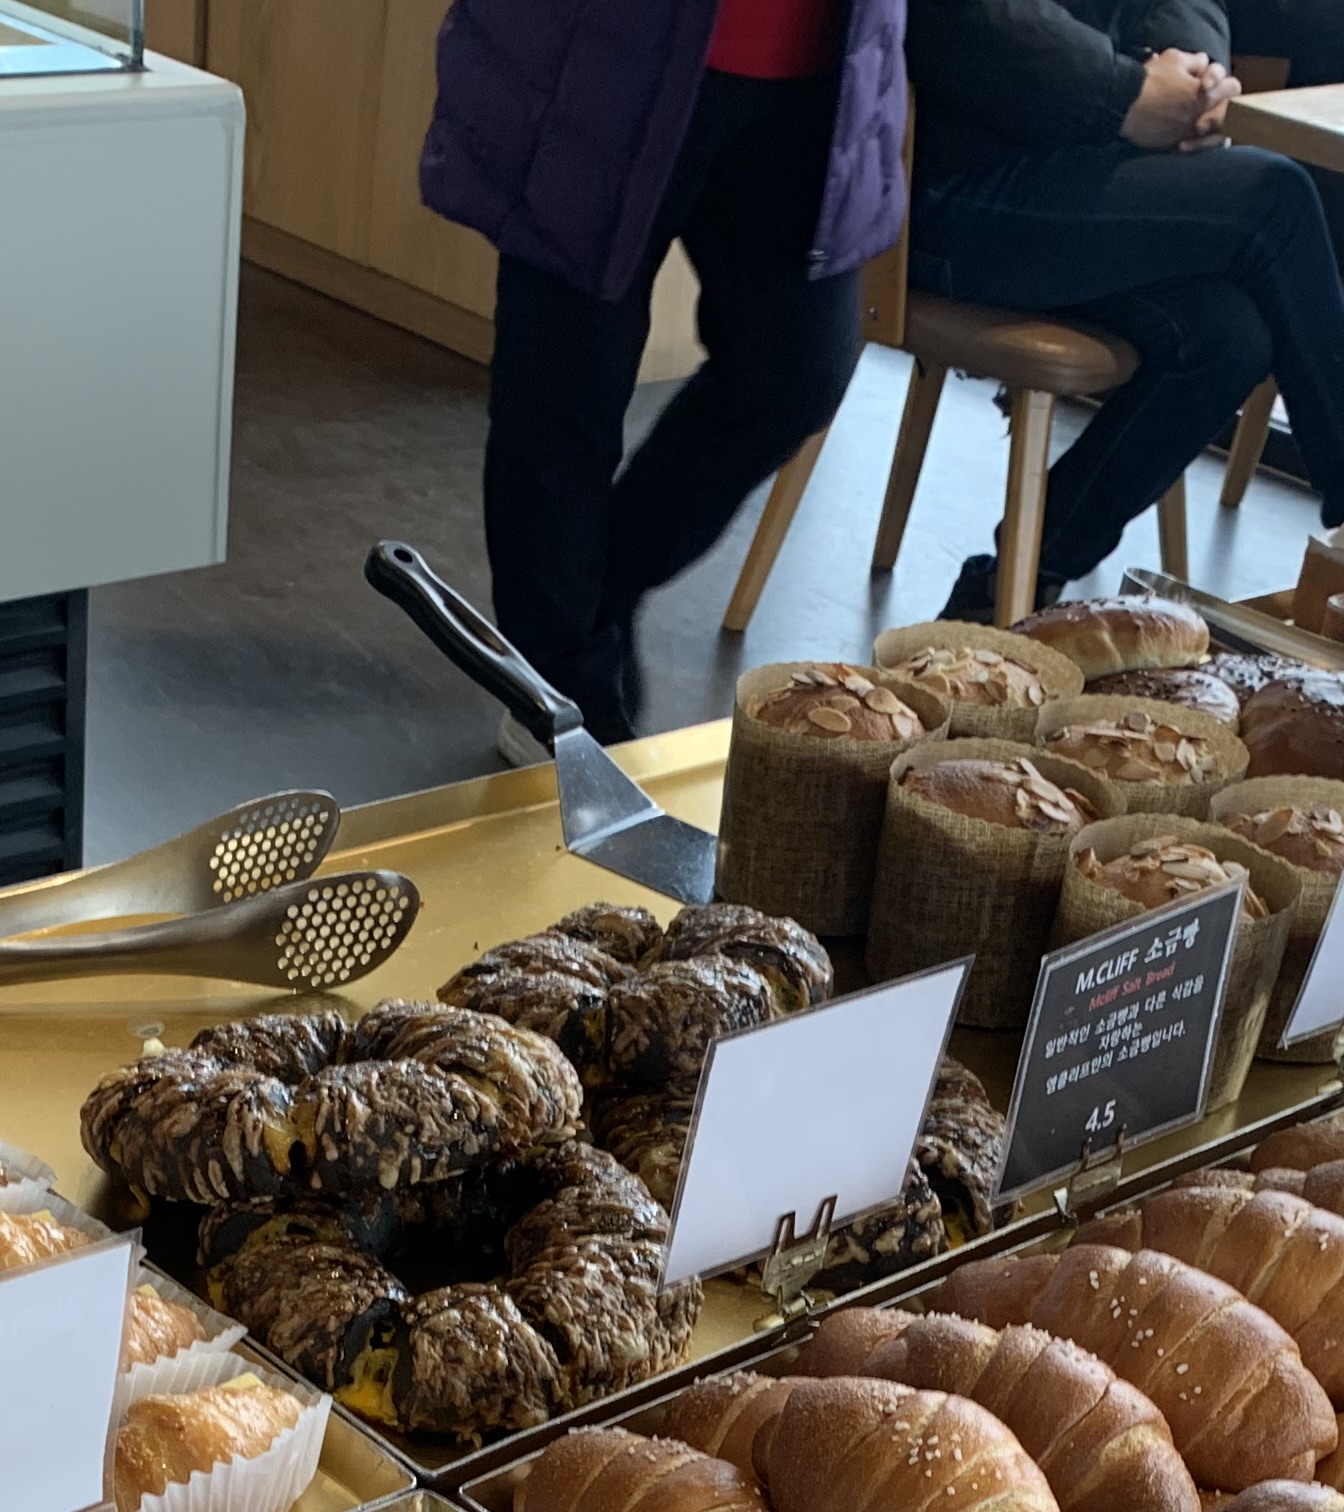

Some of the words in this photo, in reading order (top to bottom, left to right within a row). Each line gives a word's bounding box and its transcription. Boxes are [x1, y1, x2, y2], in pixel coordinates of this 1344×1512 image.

[1075, 948, 1139, 994] M.CLIFF
[1144, 917, 1200, 964] 소금빵
[1145, 961, 1176, 987] Bread
[1044, 1023, 1091, 1059] 일반적인
[1094, 1001, 1140, 1036] 소금빵과
[1144, 989, 1167, 1014] 다른
[1171, 974, 1205, 1001] 식감을
[1098, 1021, 1143, 1051] 자랑하는
[1085, 1099, 1117, 1133] 4.5
